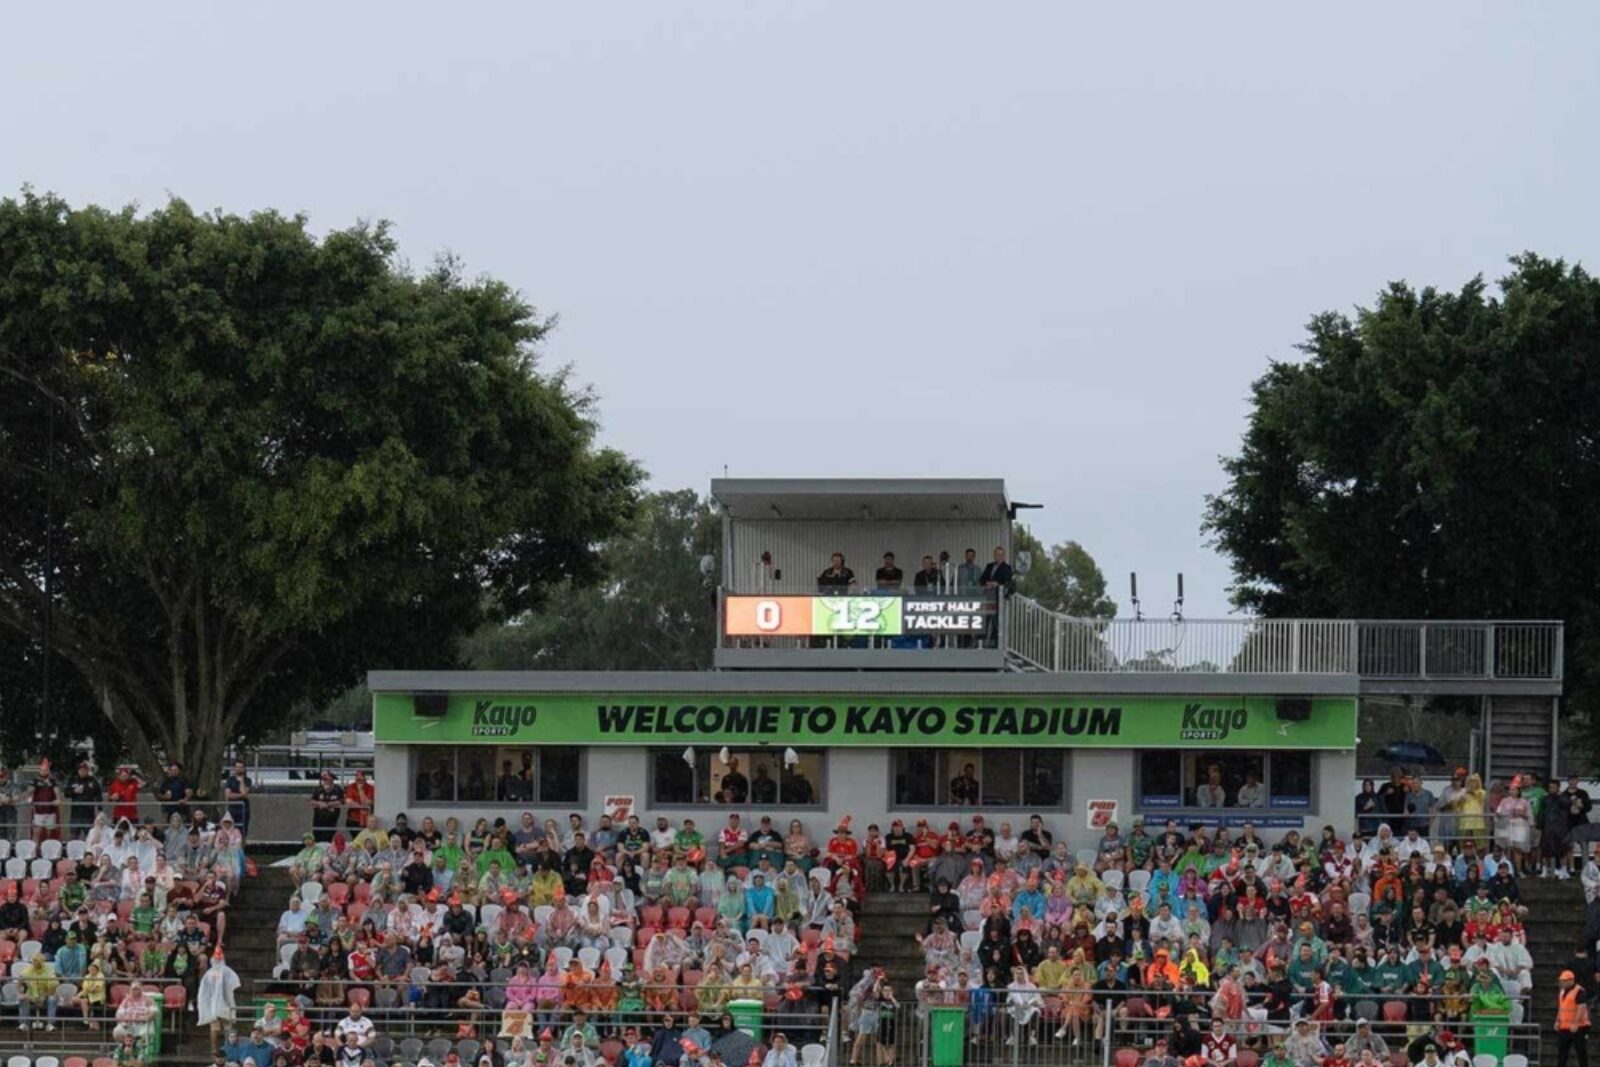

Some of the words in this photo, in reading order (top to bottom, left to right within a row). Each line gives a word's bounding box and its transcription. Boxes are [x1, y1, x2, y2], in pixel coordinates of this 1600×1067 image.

[756, 600, 781, 631] 0
[830, 600, 881, 630] 12
[904, 615, 968, 629] TACKLE
[970, 615, 983, 629] 2
[906, 601, 945, 612] FIRST
[948, 601, 980, 612] HALF
[472, 700, 537, 736] Kayo
[598, 705, 781, 734] WELCOME
[789, 706, 838, 734] TO
[844, 706, 947, 735] KAYO
[953, 706, 1123, 736] STADIUM
[1182, 703, 1248, 740] Kayo
